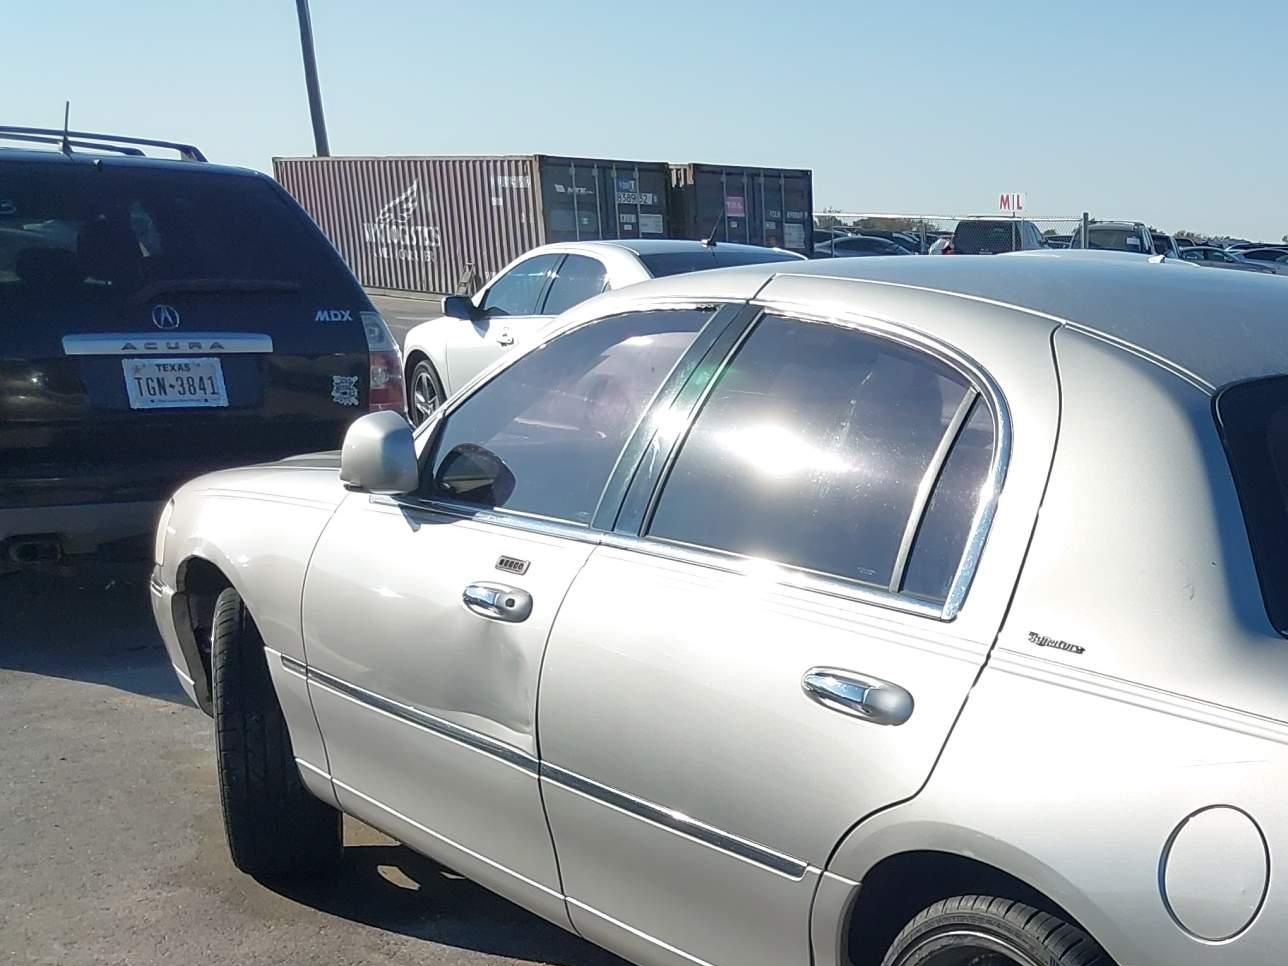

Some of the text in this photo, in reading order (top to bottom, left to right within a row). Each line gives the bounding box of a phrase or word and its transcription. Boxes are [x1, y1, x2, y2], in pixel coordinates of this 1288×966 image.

[315, 310, 353, 321] MDX
[121, 341, 225, 351] ACURA
[155, 363, 192, 373] TEXAS
